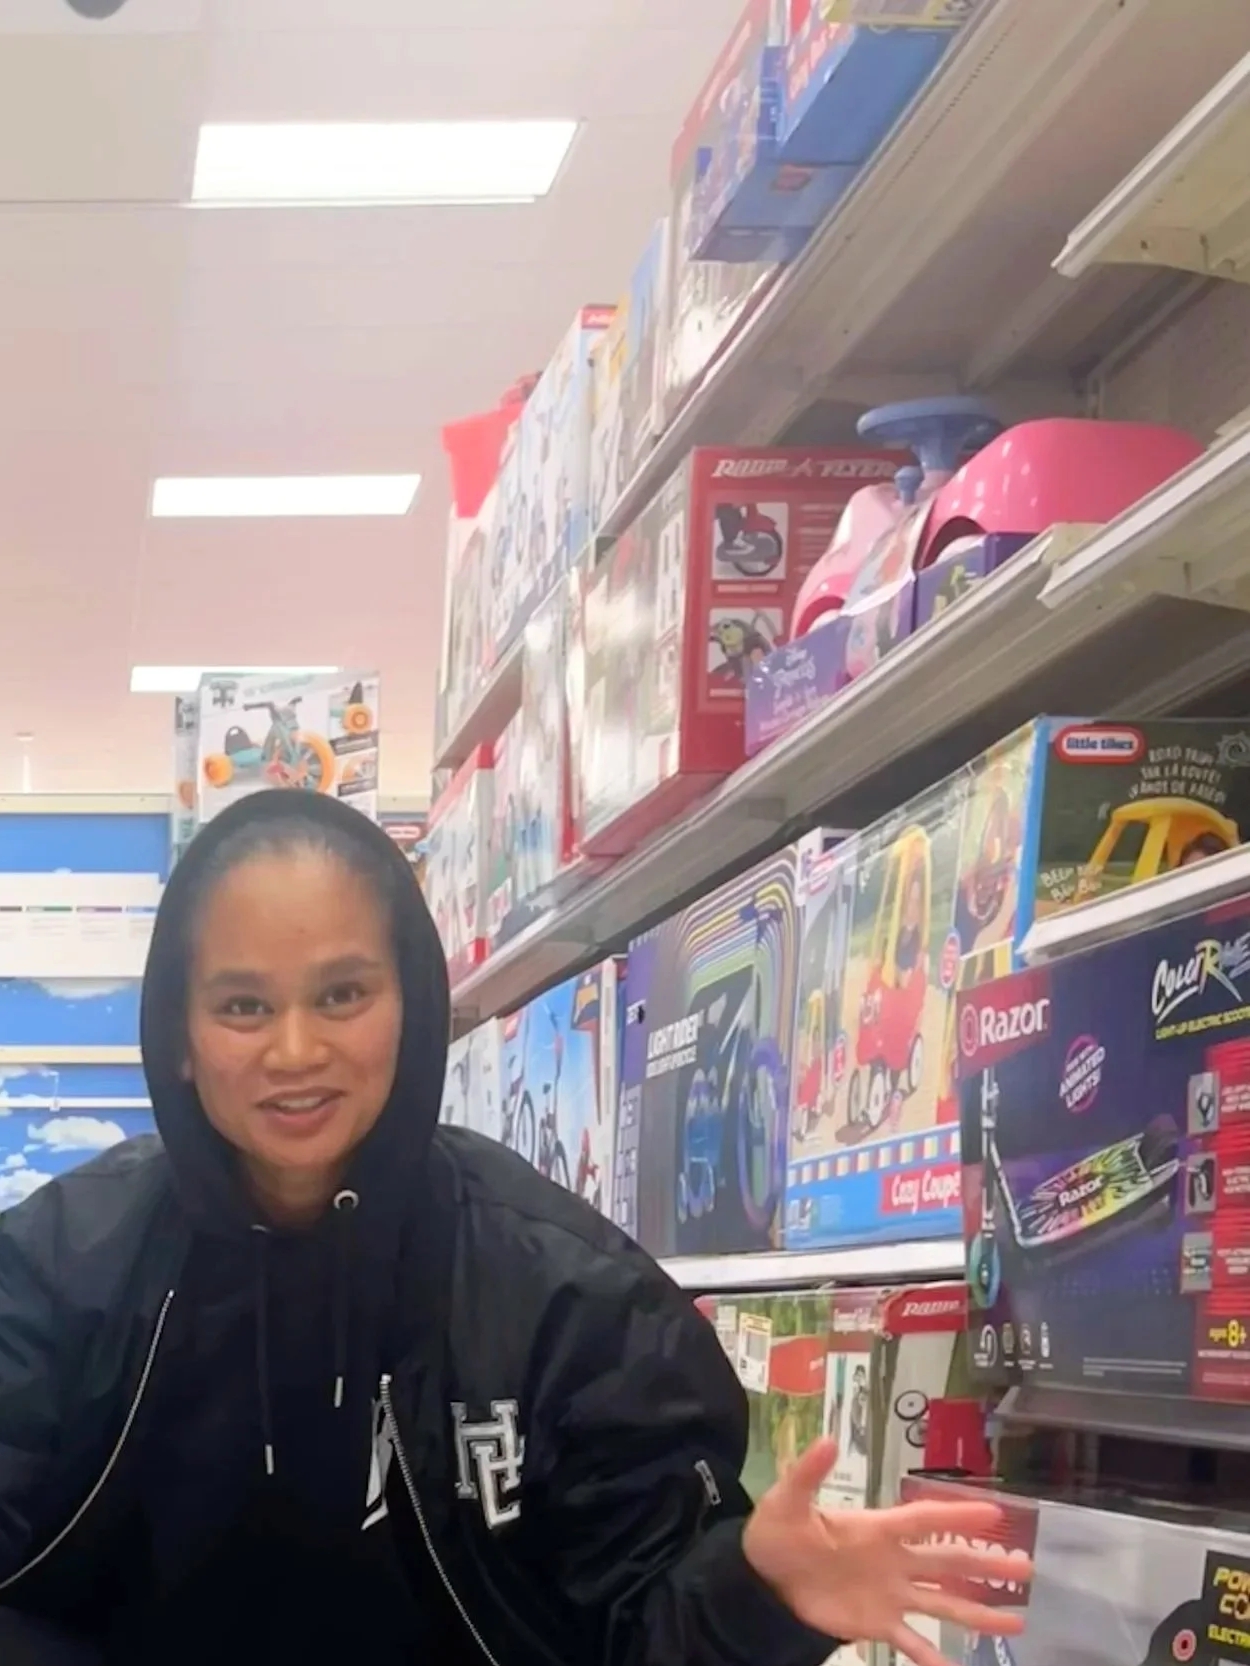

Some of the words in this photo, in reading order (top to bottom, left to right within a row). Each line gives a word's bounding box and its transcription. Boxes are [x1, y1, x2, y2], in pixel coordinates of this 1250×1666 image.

[980, 998, 1049, 1046] Razor
[891, 1170, 919, 1213] Cozy
[1059, 1175, 1105, 1208] Razor
[1228, 1319, 1247, 1348] 8+
